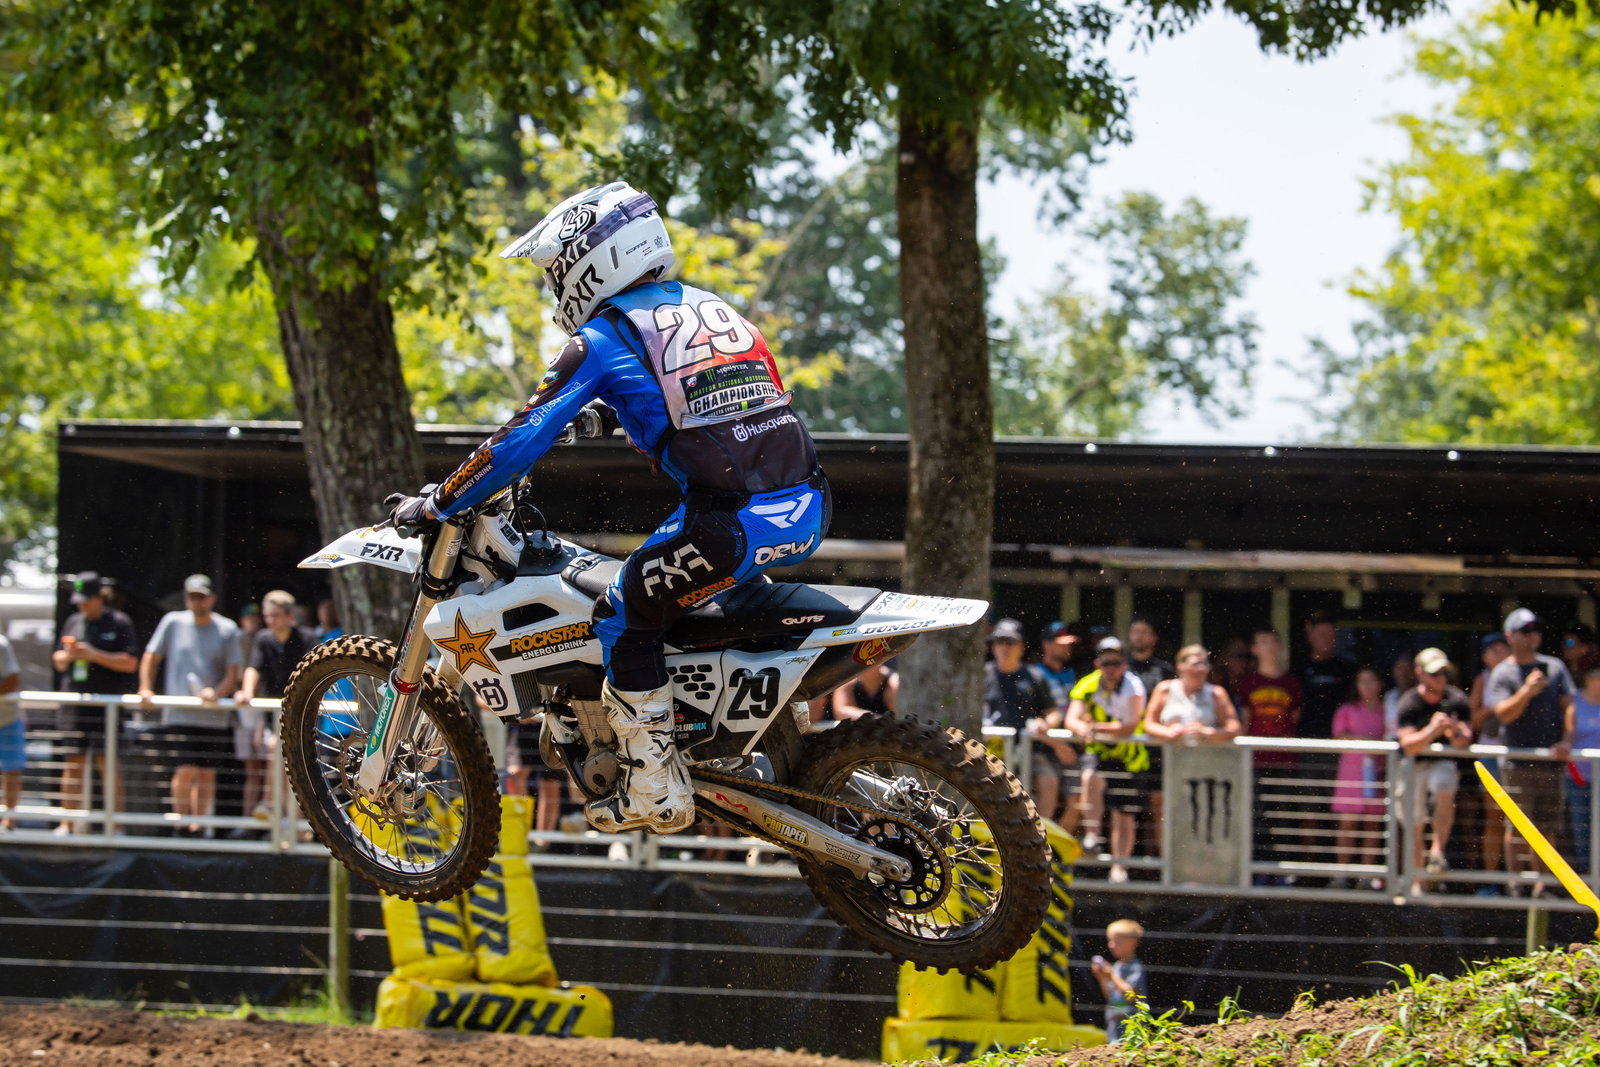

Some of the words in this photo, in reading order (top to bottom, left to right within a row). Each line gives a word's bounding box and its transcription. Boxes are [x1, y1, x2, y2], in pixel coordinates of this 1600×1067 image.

[558, 208, 592, 241] 6D
[551, 233, 591, 284] FXR
[562, 263, 605, 329] FXR
[653, 299, 755, 376] 29
[716, 363, 749, 376] MONSTER
[718, 377, 744, 388] NATIONAL
[694, 383, 777, 415] CHAMPIONSHIP
[745, 414, 798, 437] Husqvarna
[444, 448, 494, 497] ROCKSTAR
[453, 477, 475, 499] ENERGY
[473, 463, 494, 481] DRINK
[360, 542, 405, 562] FXR
[641, 543, 714, 597] FXR
[676, 576, 739, 608] ROCKSTAR
[781, 614, 826, 626] GUTS
[863, 620, 937, 635] DUNLOP
[510, 623, 589, 653] ROCKSTAR
[522, 645, 557, 660] ENERGY
[558, 639, 586, 651] DRINK
[727, 667, 781, 721] 29
[375, 694, 393, 737] MOTOREX
[764, 816, 807, 845] PROTAPER
[425, 991, 585, 1038] THOR
